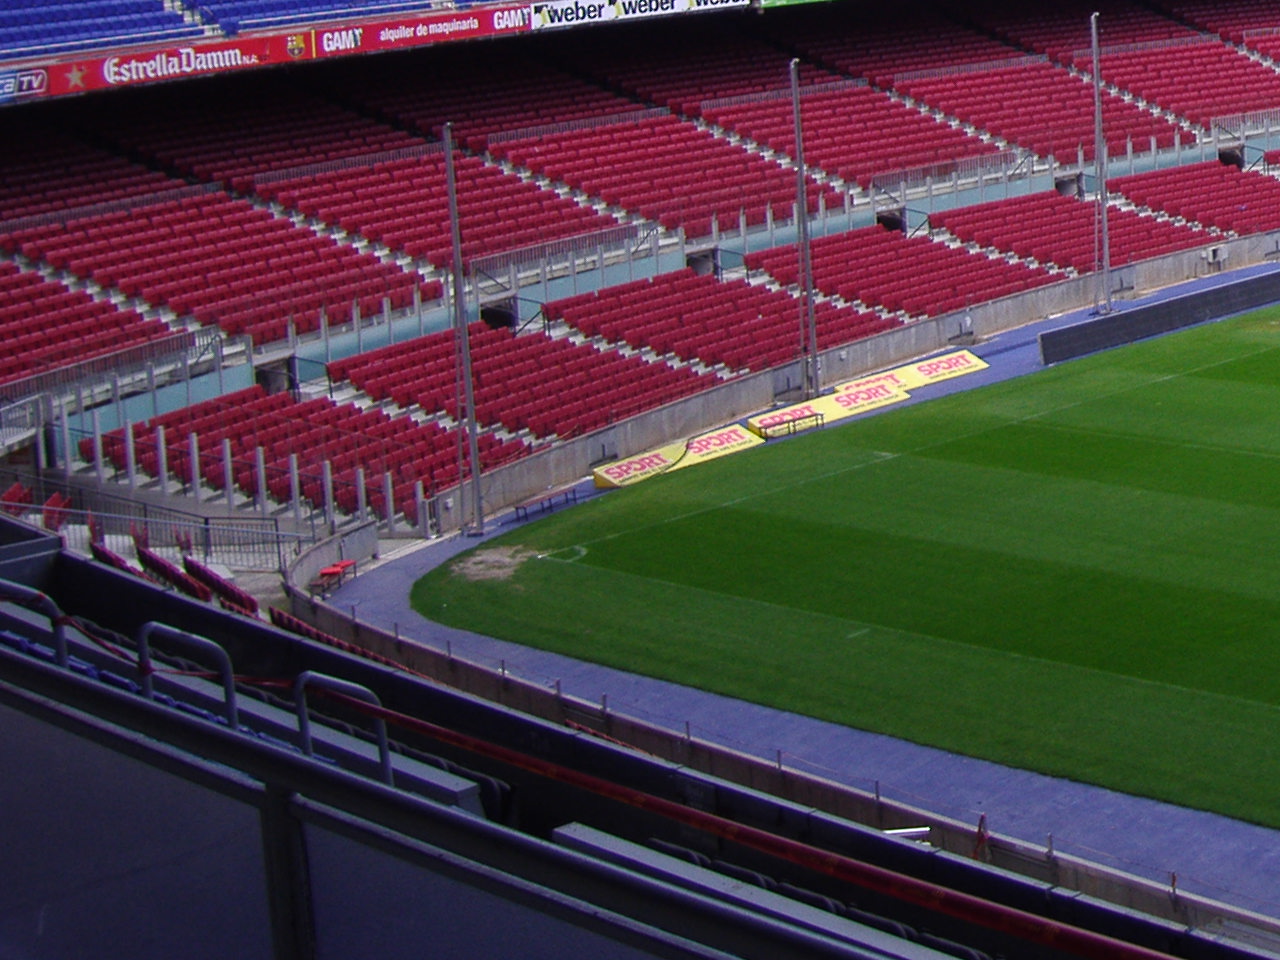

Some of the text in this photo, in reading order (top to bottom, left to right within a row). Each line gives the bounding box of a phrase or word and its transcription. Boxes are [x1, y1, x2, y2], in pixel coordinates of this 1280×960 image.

[548, 1, 605, 24] weber
[379, 17, 480, 43] alquiler de maquinaria
[103, 56, 181, 84] Estrella
[179, 47, 243, 73] Damm
[19, 74, 44, 90] TV
[916, 353, 974, 377] SPORT
[834, 383, 893, 408] SPORT
[688, 428, 746, 454] SPORT
[603, 452, 669, 480] SPORT
